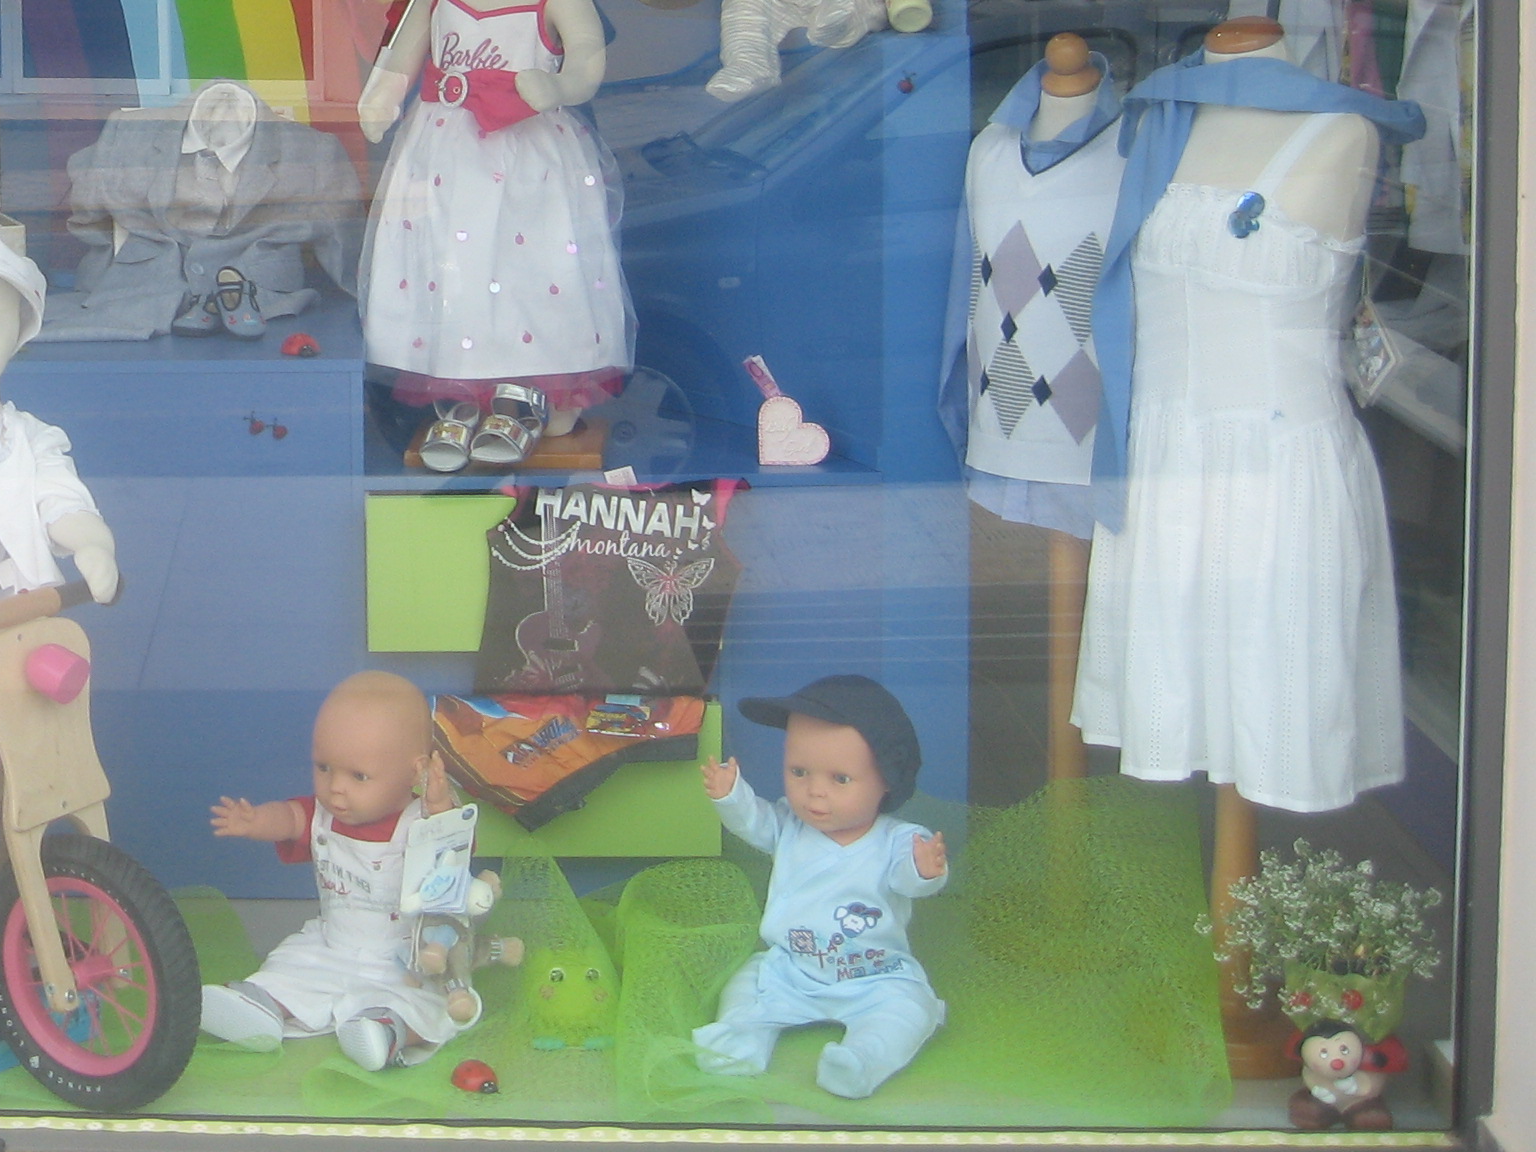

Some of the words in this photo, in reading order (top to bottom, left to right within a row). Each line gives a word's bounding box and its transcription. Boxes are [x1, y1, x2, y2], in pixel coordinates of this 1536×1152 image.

[439, 32, 509, 71] Barbie
[535, 487, 701, 541] HANNAH
[568, 530, 671, 558] montana
